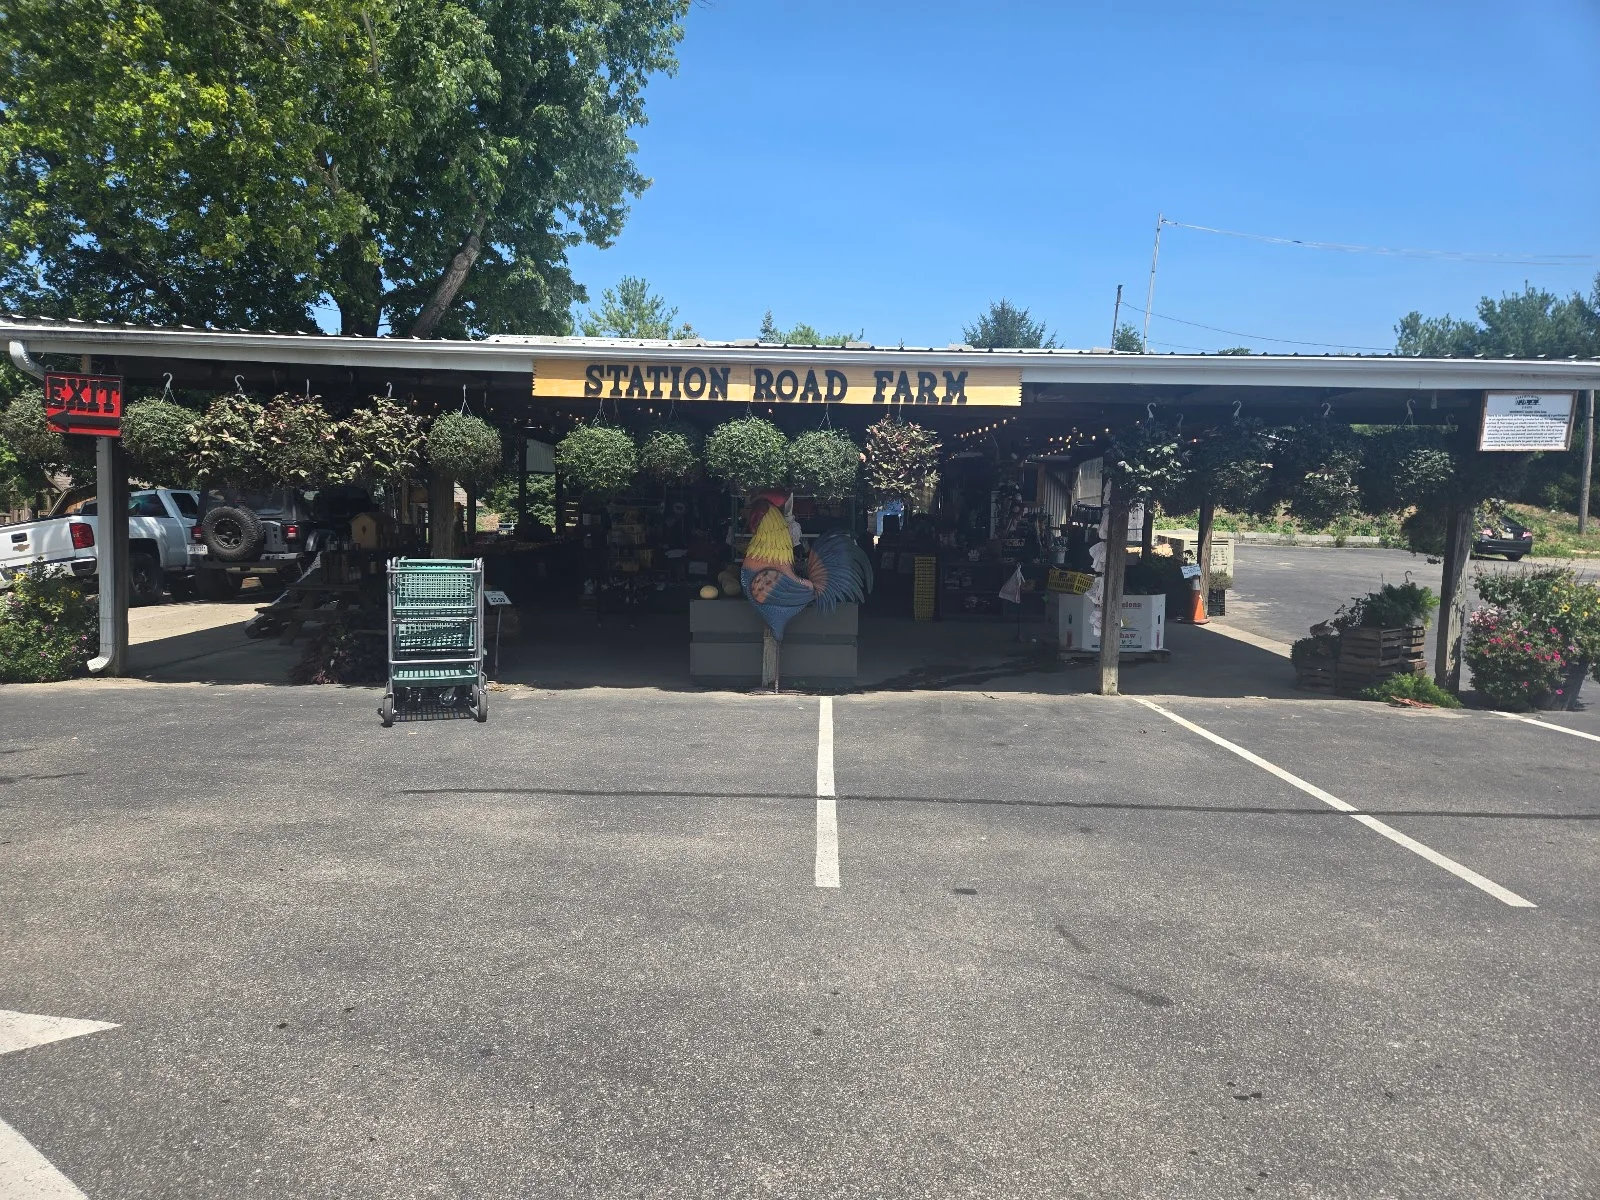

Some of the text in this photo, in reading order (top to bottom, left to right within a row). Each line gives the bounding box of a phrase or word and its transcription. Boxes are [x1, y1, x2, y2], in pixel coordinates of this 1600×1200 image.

[48, 377, 119, 412] EXIT
[584, 364, 969, 405] STATION ROAD FARM
